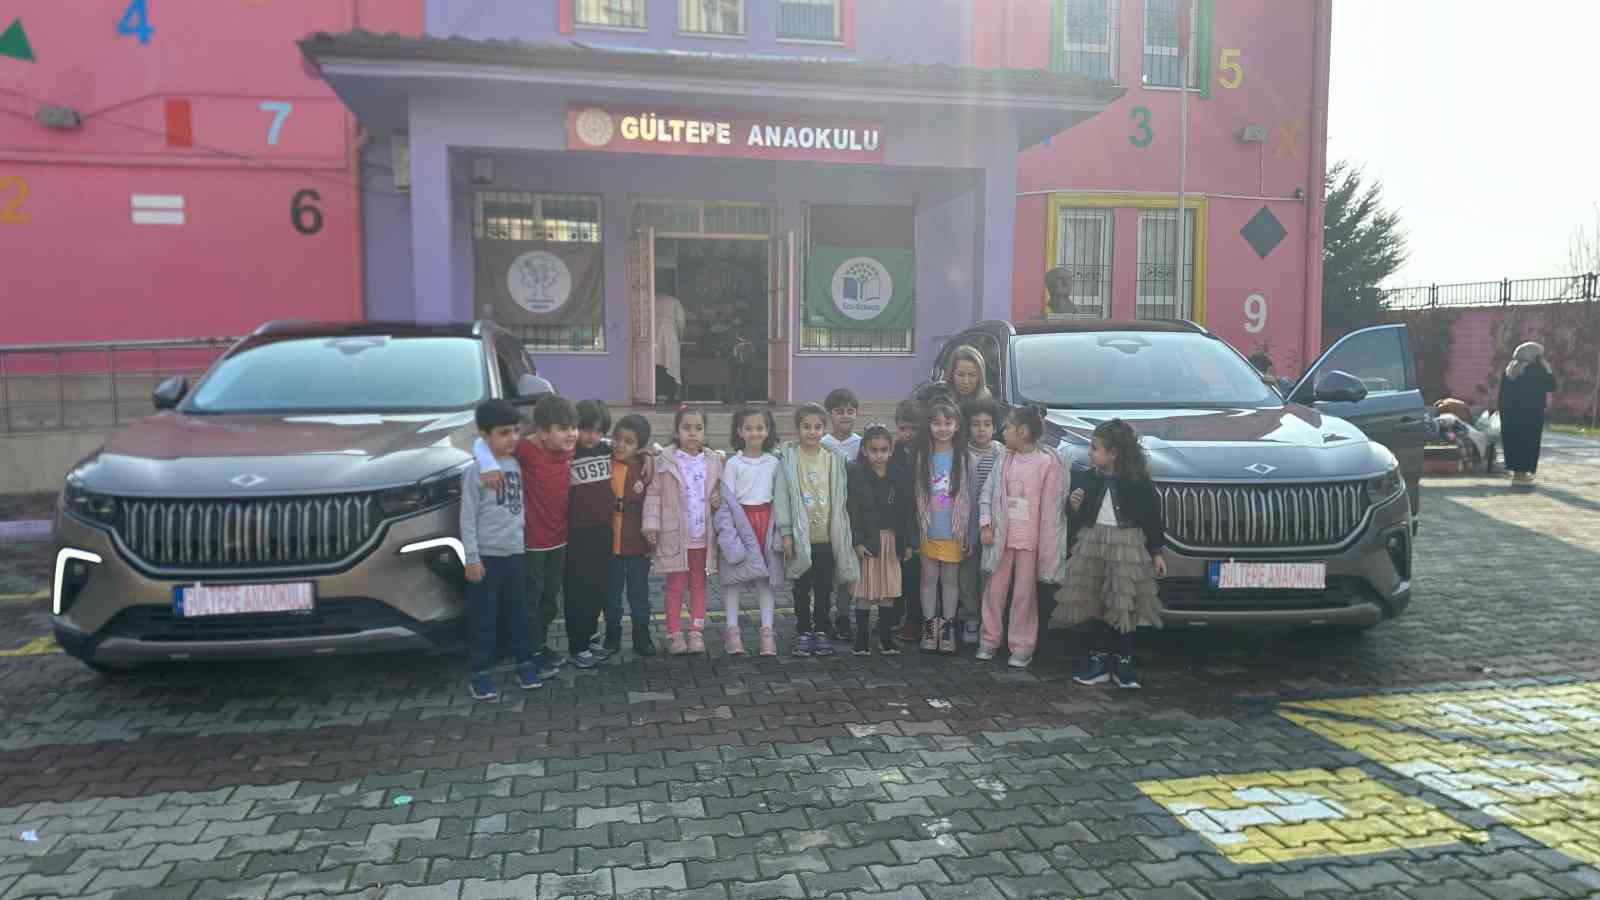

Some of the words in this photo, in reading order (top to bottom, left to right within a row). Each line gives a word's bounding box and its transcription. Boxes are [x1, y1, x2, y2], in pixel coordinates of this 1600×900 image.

[117, 0, 155, 44] 4
[1217, 48, 1245, 89] 5
[258, 101, 293, 145] 7
[620, 112, 731, 145] GÜLTEPE
[747, 124, 880, 151] ANAOKULU
[1128, 106, 1153, 148] 3
[0, 175, 33, 225] 2
[290, 188, 324, 236] 6
[1244, 294, 1267, 333] 9
